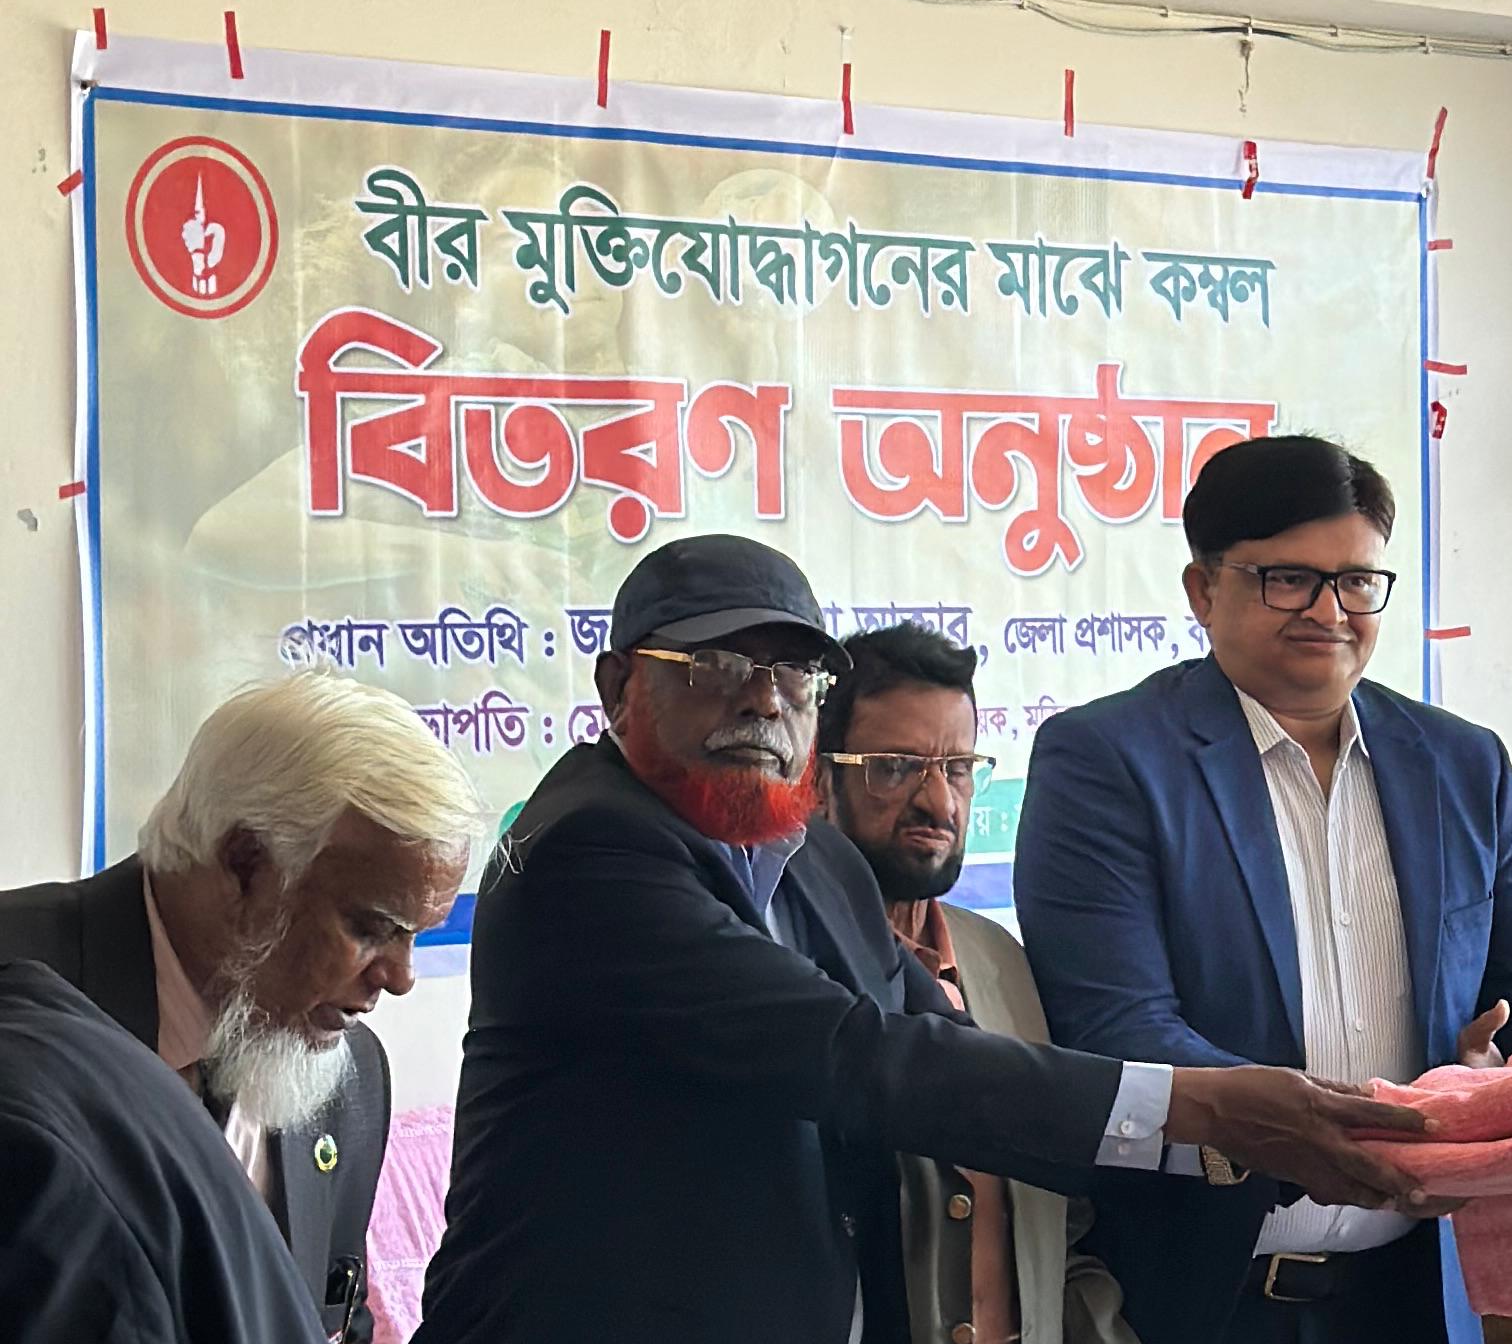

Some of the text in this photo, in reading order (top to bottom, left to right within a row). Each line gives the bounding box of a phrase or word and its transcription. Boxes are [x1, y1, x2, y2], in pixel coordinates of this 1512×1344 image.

[355, 168, 1277, 329] বীর মুক্তিযোদ্ধাগনের মাঝে কম্বল
[297, 308, 793, 541] বিতরণ
[396, 606, 530, 665] অতিথি
[1003, 613, 1067, 654] জেলা
[1075, 610, 1180, 660] প্রশাসক,
